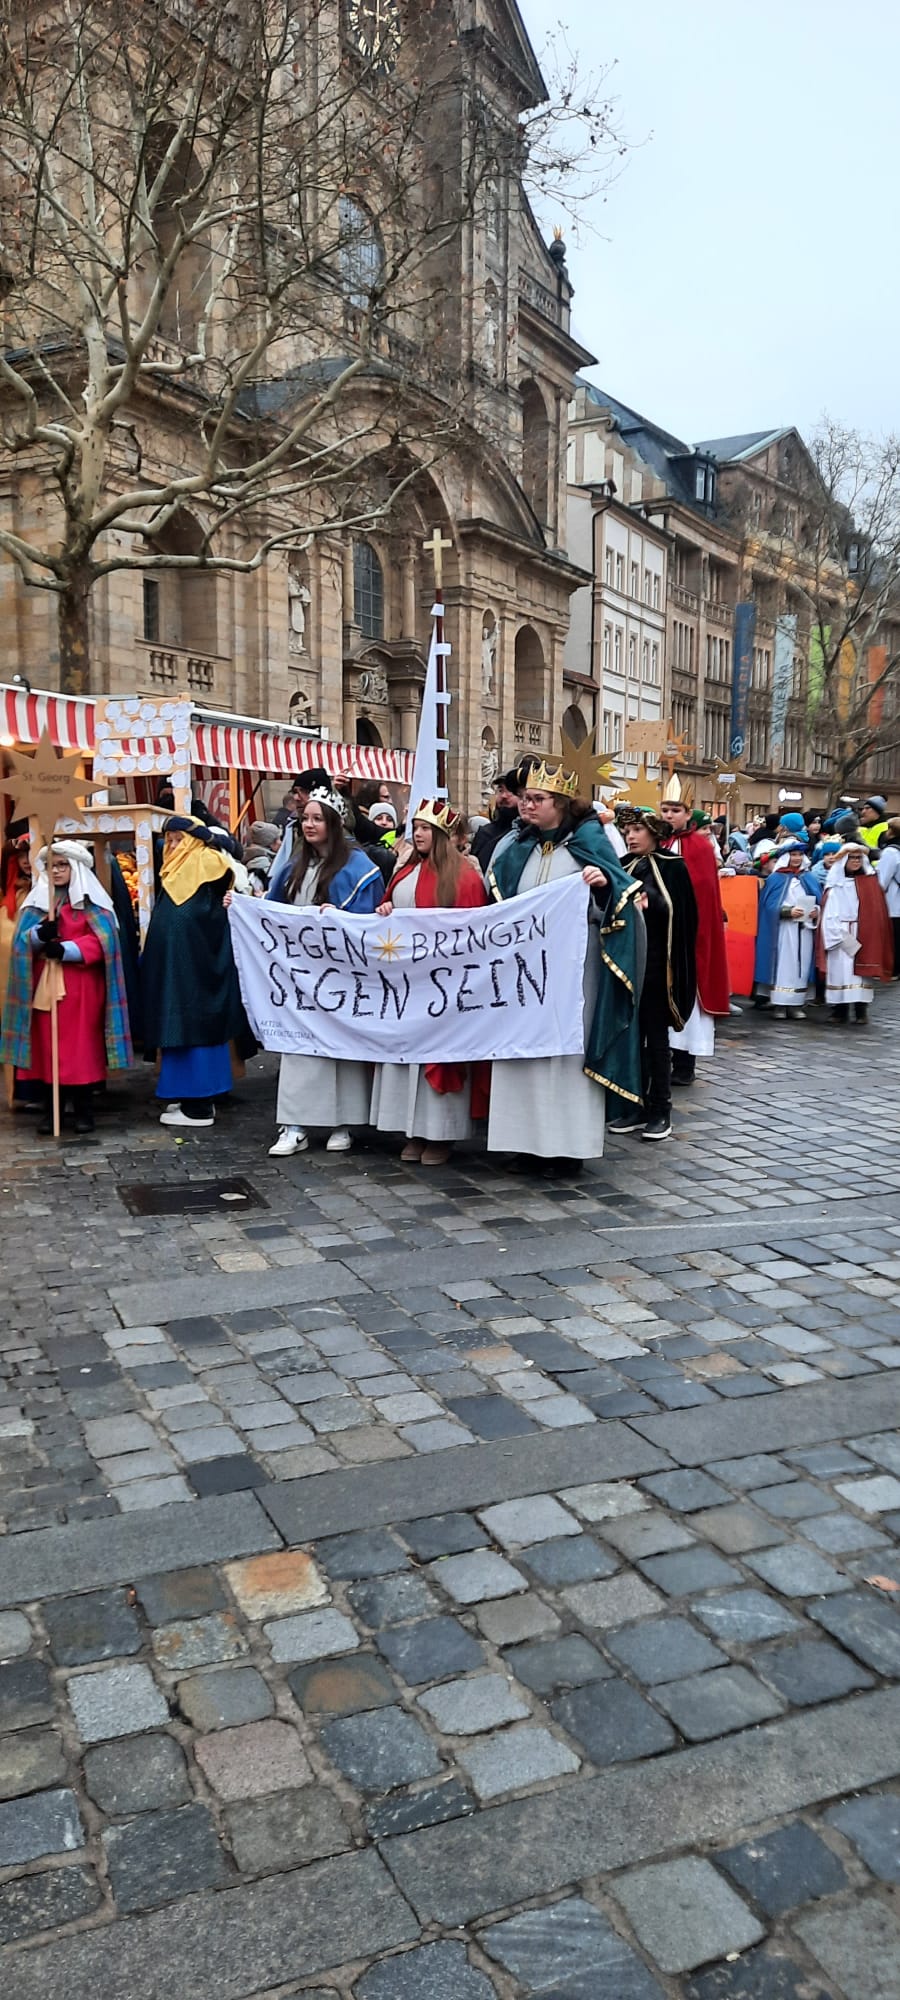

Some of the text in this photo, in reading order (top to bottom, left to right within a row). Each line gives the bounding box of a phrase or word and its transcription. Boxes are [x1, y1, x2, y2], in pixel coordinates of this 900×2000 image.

[38, 771, 71, 785] Georg
[260, 914, 546, 967] SEGEN BRINGEN
[269, 950, 548, 1020] SEGEN SEIN
